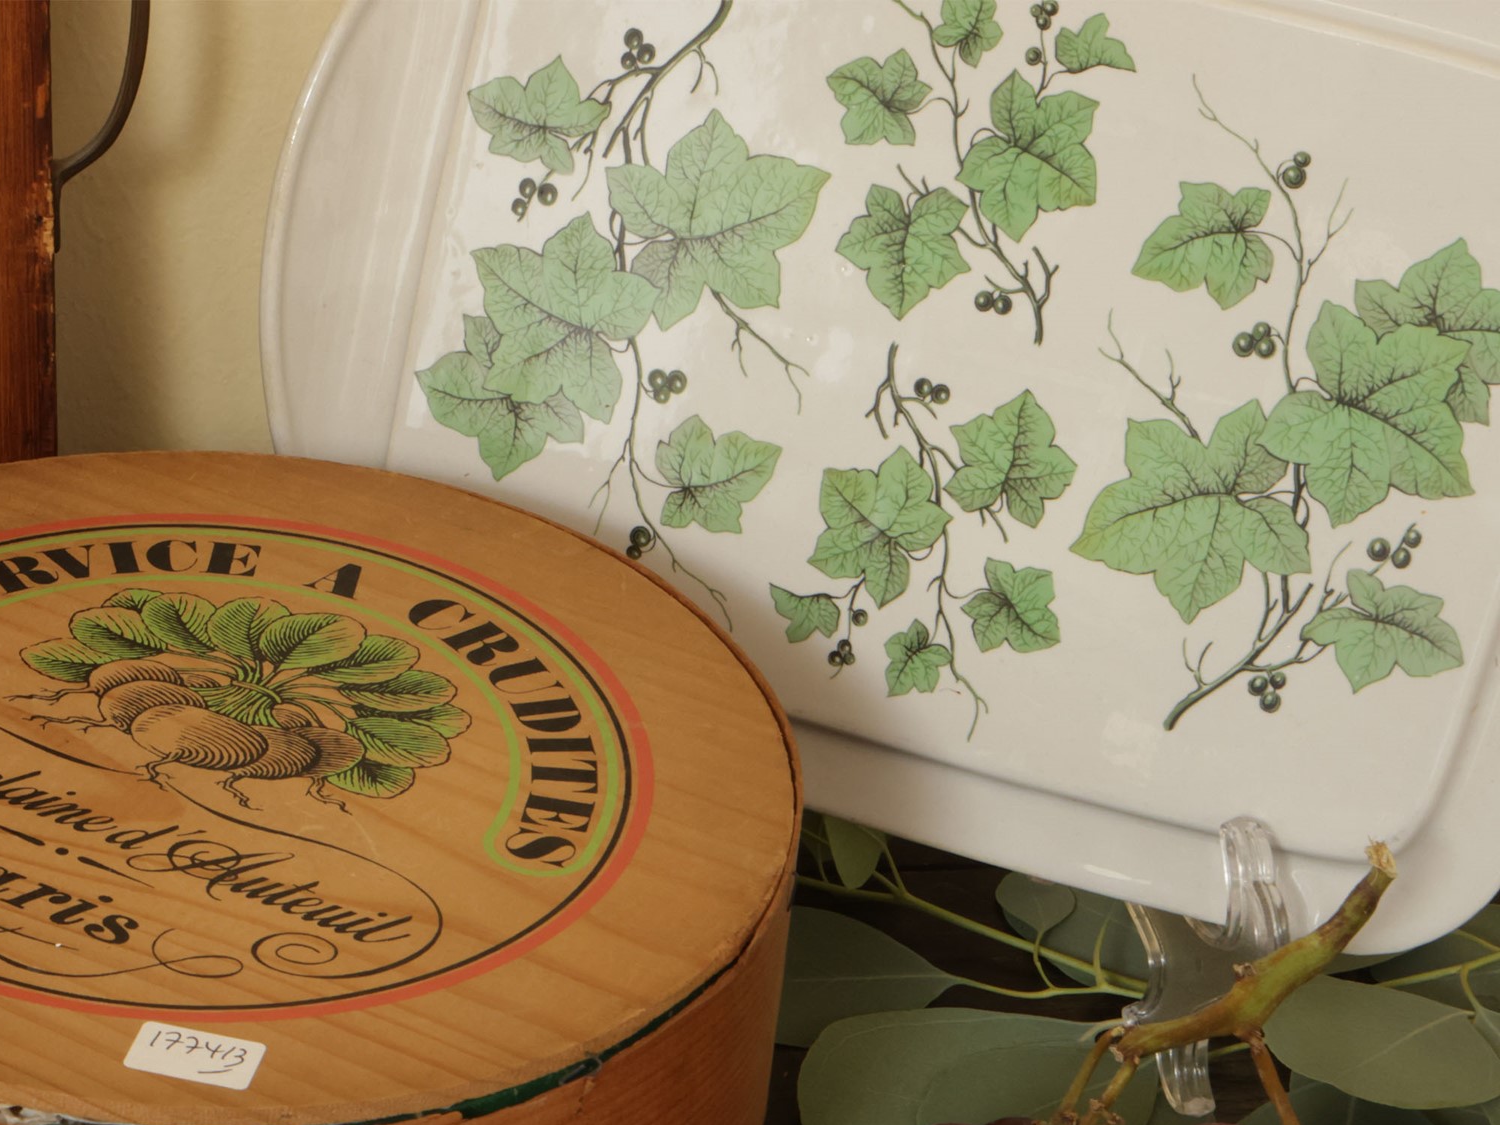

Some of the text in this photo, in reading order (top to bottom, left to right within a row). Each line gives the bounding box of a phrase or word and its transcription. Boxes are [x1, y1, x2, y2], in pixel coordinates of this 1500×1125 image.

[303, 563, 362, 599] A
[408, 599, 598, 868] CRUDITES
[149, 1030, 248, 1068] 177413
